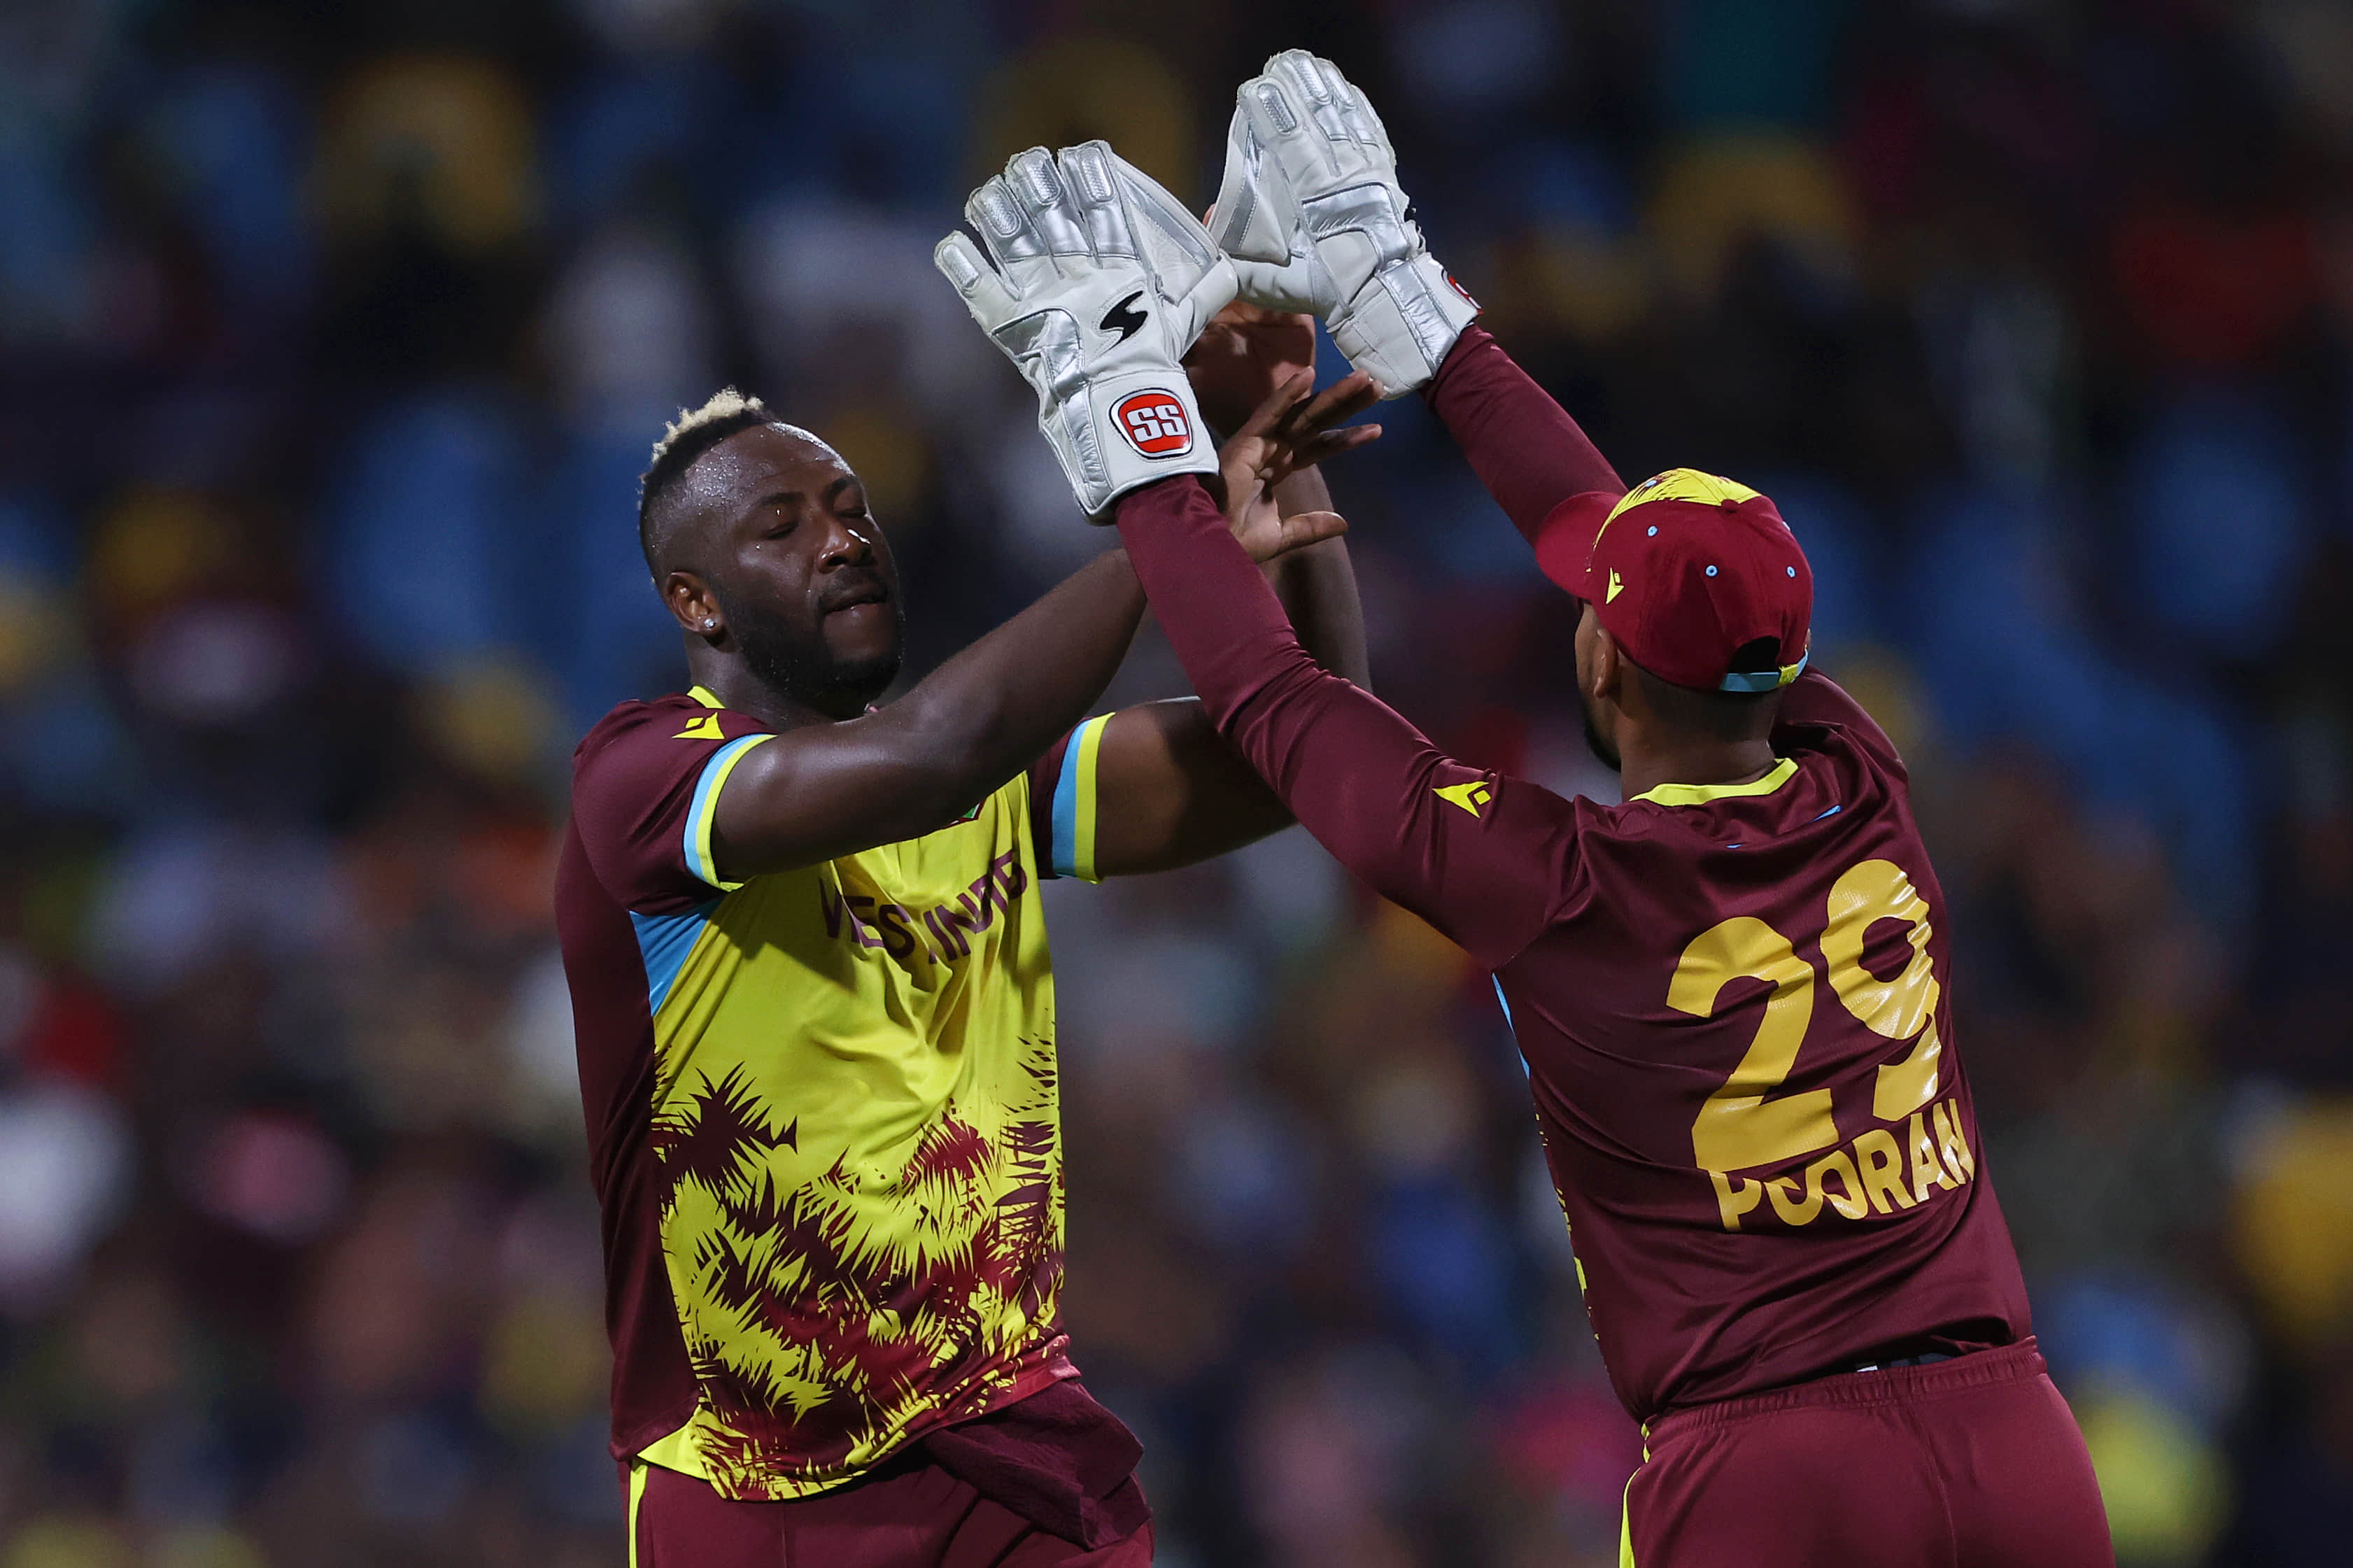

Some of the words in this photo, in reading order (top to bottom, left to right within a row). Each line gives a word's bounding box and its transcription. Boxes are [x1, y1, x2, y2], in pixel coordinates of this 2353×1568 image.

[1126, 404, 1188, 443] SS
[1665, 859, 1942, 1173] 29
[1707, 1098, 1975, 1231] POORAN
